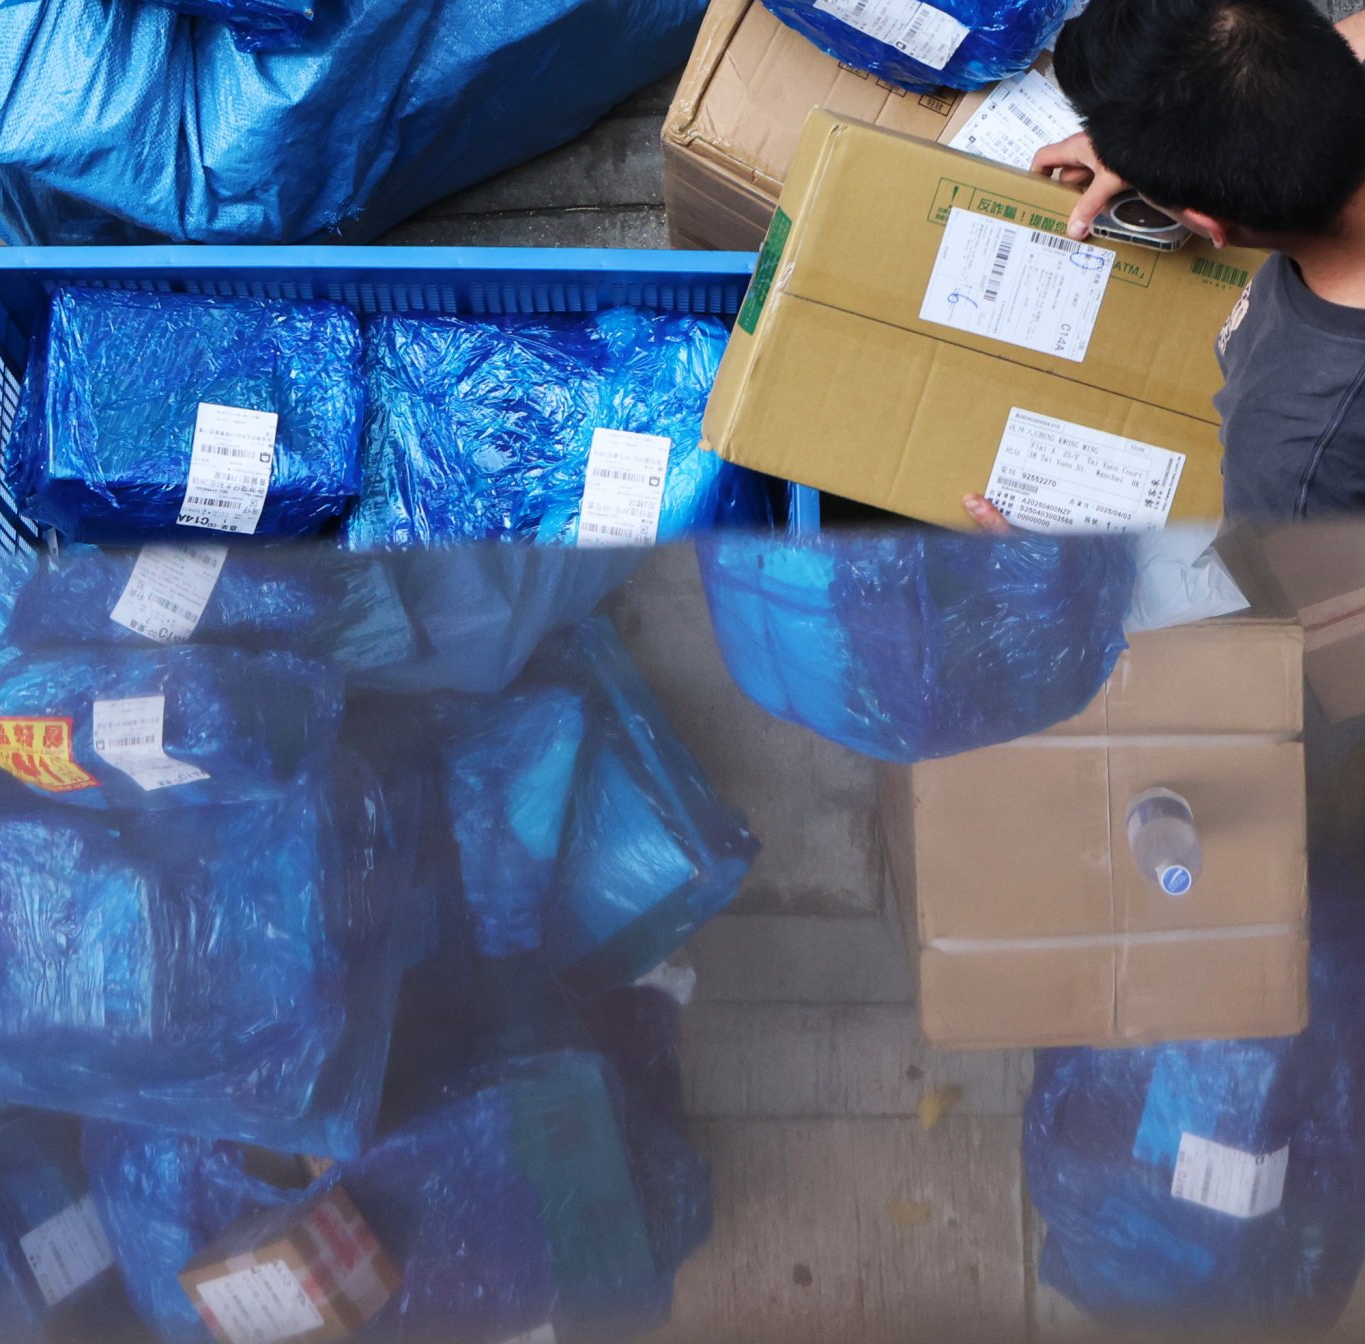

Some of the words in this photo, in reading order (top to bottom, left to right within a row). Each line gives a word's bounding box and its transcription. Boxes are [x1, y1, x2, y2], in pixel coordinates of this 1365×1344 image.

[1053, 322, 1071, 353] C14A
[1095, 468, 1124, 483] Wanchai
[177, 512, 209, 525] C14A
[1094, 504, 1132, 521] 2025/04/03
